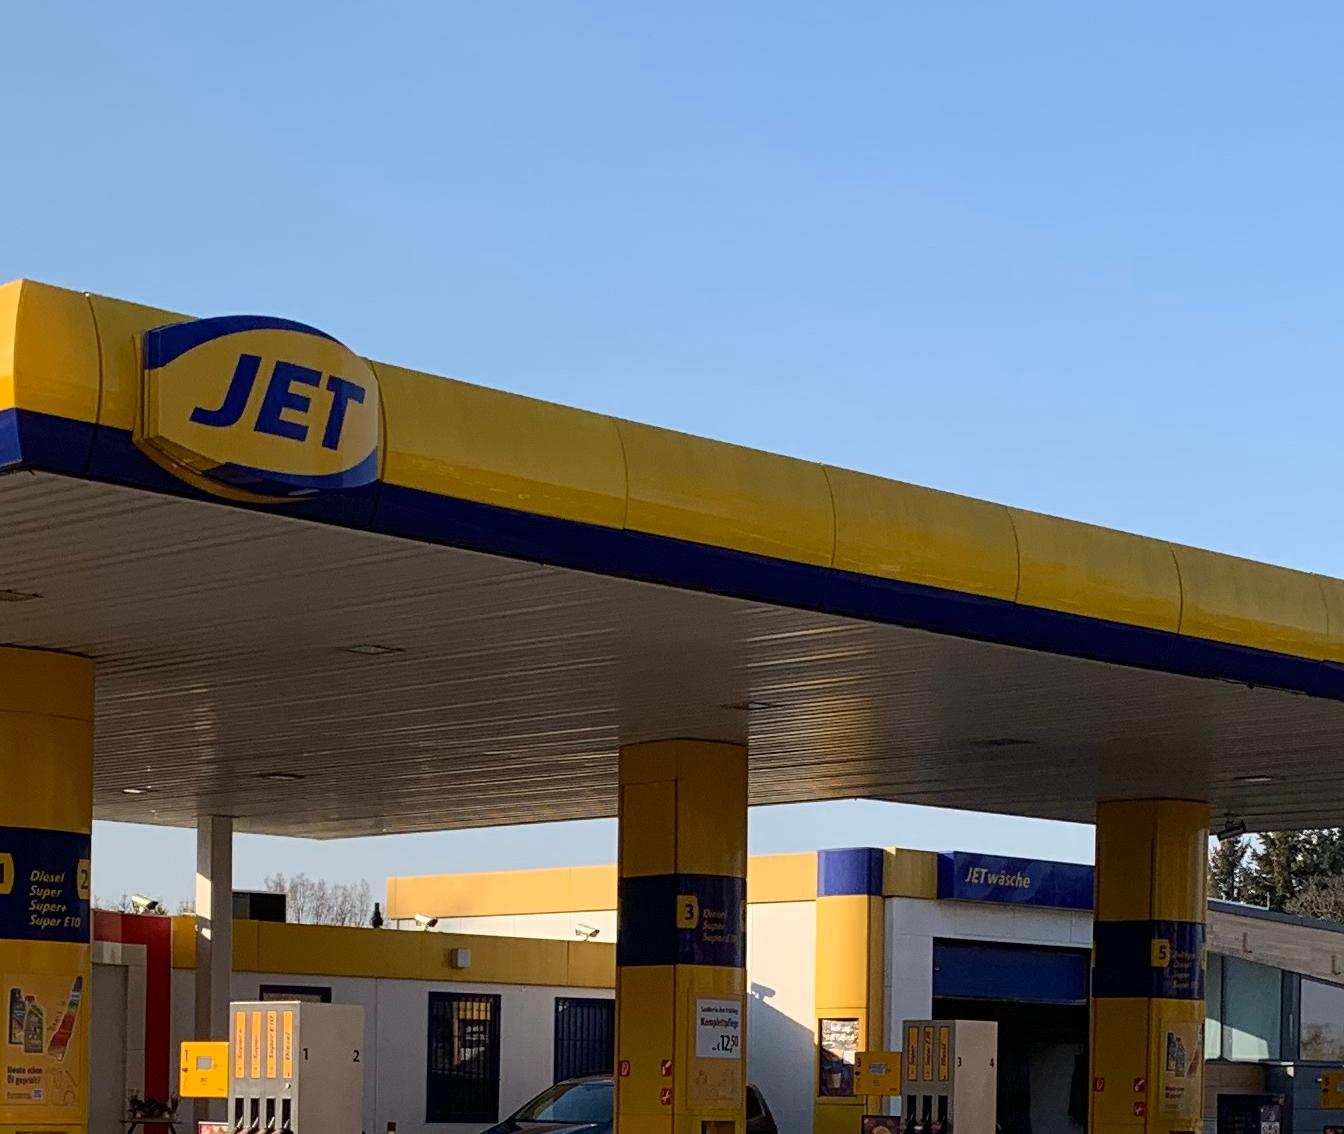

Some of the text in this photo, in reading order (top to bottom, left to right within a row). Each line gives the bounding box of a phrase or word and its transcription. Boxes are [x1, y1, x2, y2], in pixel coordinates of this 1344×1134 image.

[189, 354, 366, 450] JET
[30, 870, 65, 883] Diesel
[81, 869, 89, 890] 2
[29, 885, 62, 899] Super
[29, 900, 67, 914] Super+
[684, 904, 694, 920] 3
[29, 914, 81, 928] Super E10
[1159, 945, 1167, 960] 5
[303, 1048, 308, 1060] 1
[353, 1050, 360, 1062] 2
[957, 1057, 962, 1067] 3
[989, 1058, 995, 1068] 4
